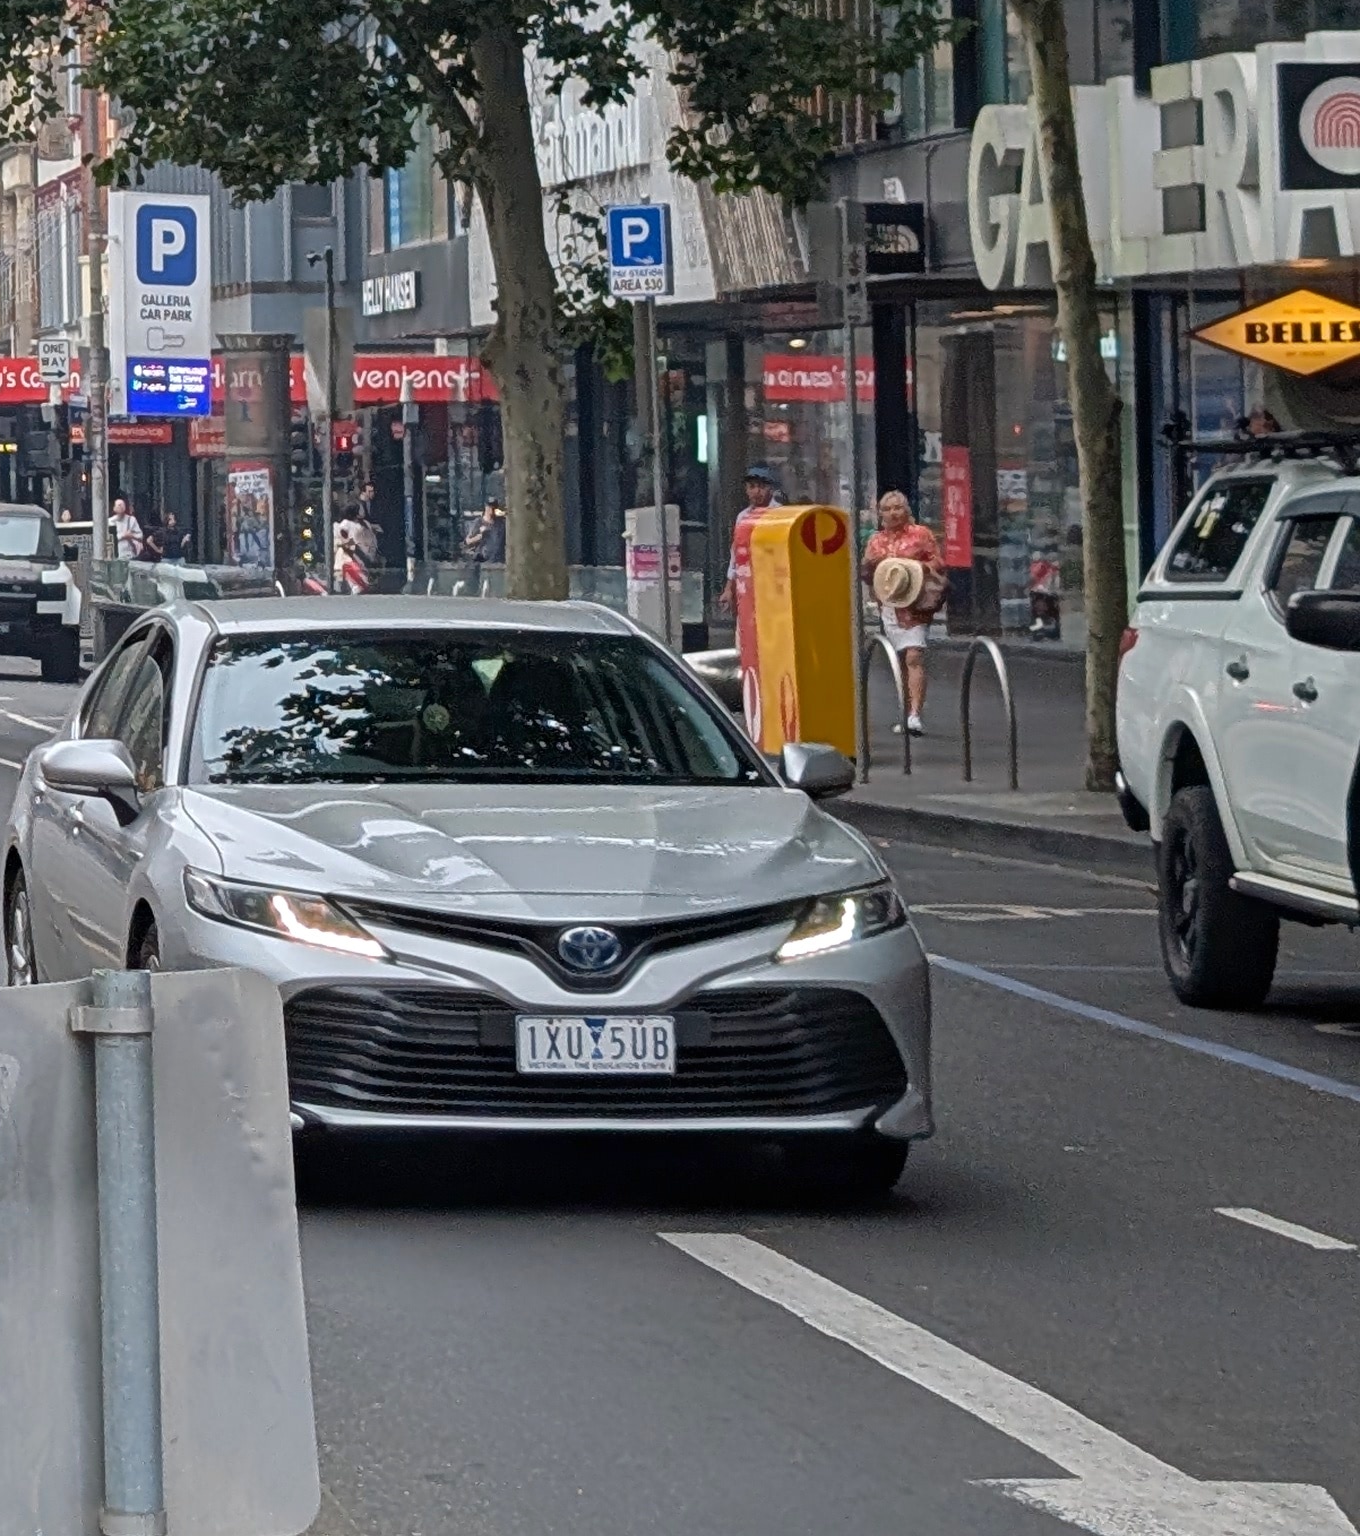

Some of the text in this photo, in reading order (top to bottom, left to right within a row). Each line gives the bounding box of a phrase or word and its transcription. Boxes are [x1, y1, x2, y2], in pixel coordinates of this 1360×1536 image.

[968, 34, 1360, 291] GALERI
[621, 217, 650, 258] P
[151, 218, 186, 272] P
[613, 279, 641, 291] AREA
[141, 294, 191, 307] GALLERIA
[140, 308, 192, 322] CAR PARK
[42, 343, 65, 354] ONE
